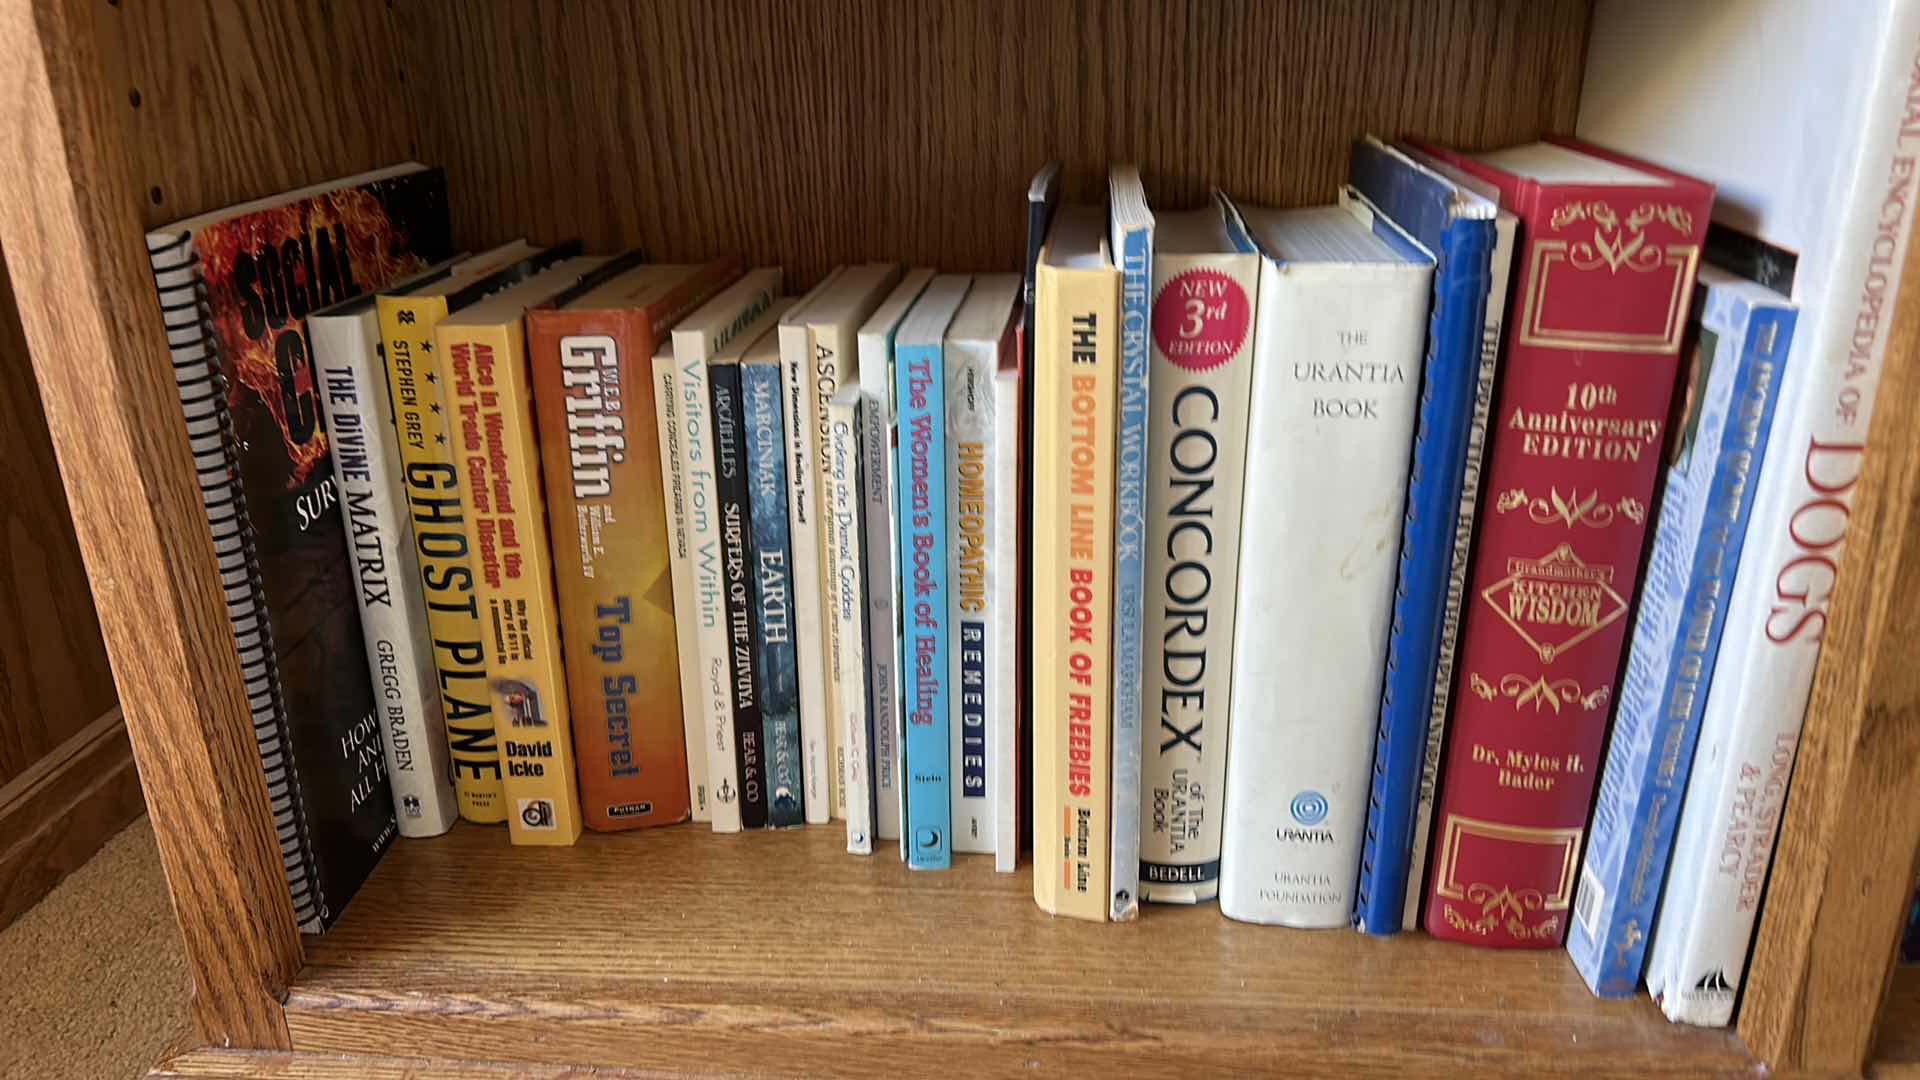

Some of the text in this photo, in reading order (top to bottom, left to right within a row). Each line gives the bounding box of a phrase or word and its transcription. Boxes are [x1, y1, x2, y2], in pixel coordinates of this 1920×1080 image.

[1179, 279, 1228, 298] NEW
[1179, 298, 1228, 339] 3rd
[1168, 339, 1233, 356] EDITION
[1338, 328, 1369, 346] THE
[393, 340, 425, 450] STEPHEN GREY
[1118, 248, 1147, 561] THE CRYSTAL WORKBOOK
[1293, 361, 1405, 385] URANTIA
[1566, 382, 1617, 411] 10th
[1765, 154, 1916, 646] ENCYCLOPEDIA OF DOGS
[560, 336, 625, 498] Griffin
[753, 380, 777, 497] MARCINIAK
[1312, 397, 1379, 420] BOOK
[1509, 406, 1662, 444] Anniversary
[450, 343, 501, 589] World Trade Center Disaster
[473, 342, 522, 580] Alice in Wonderland and the
[868, 399, 883, 505] EMPOWERMENT
[1522, 432, 1643, 463] EDITION
[325, 366, 358, 406] THE
[345, 489, 392, 609] MATRIX
[682, 360, 720, 628] Visitors from Within
[908, 356, 940, 727] The Women's Book of Healing
[1068, 311, 1096, 797] THE BOTTOM LINE BOOK OF FREEBIES
[1159, 386, 1219, 755] CONCORDEX
[406, 462, 503, 780] GHOST PLANE
[724, 502, 753, 710] SURFERS OF THE ZUVUYA
[759, 549, 788, 644] EARTH
[958, 441, 986, 788] HOMEOPATHIC REMEDIES
[1507, 592, 1602, 626] WISDOM
[1512, 579, 1602, 600] KITCHEN
[376, 640, 401, 700] GREGG
[592, 596, 641, 777] Top Secret
[877, 663, 888, 692] JOHN
[711, 657, 727, 753] Royal & Priest
[775, 720, 788, 749] BEAR
[879, 695, 891, 757] RANDOLPH
[387, 706, 414, 772] BRADEN
[505, 741, 553, 758] David
[508, 761, 545, 777] Icke
[742, 731, 759, 803] BEAR & CO
[1472, 744, 1585, 774] Dr. Myles H.
[1153, 787, 1169, 833] Book
[1169, 768, 1188, 856] URANTIA
[1187, 781, 1205, 841] of The
[1275, 828, 1335, 844] URANTIA
[1719, 761, 1761, 877] & PEARCY
[1077, 807, 1091, 893] Bottom Line
[1149, 865, 1205, 882] BEDELL
[1274, 871, 1331, 887] URANTIA
[1259, 887, 1343, 904] FOUNDATION
